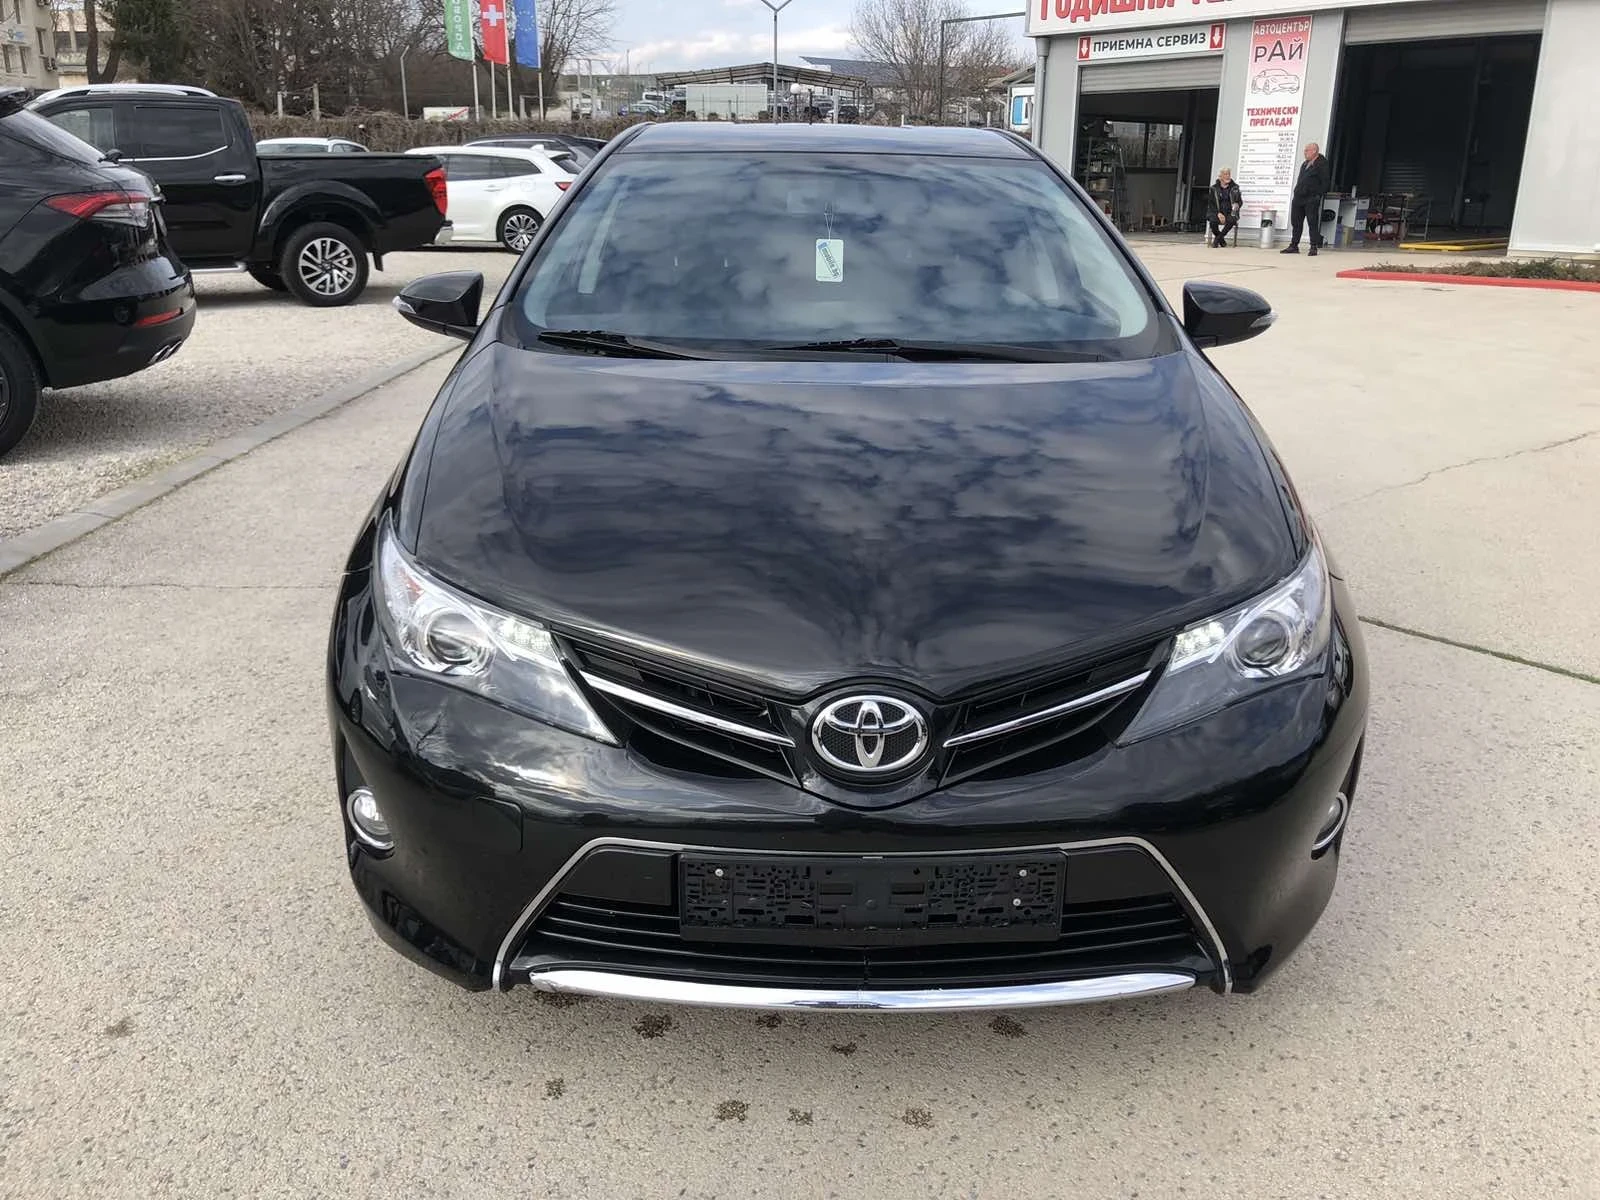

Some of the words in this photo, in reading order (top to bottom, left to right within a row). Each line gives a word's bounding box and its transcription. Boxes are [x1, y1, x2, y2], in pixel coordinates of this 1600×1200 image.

[1040, 0, 1175, 23] ГОДИ
[1253, 20, 1309, 35] АВТОЦЕНТЪР
[1093, 35, 1153, 53] ПРИЕМНА
[1157, 32, 1206, 48] СЕРВИЗ
[1254, 38, 1304, 63] РАЙ
[1246, 106, 1299, 117] ТЕХНИЧЕСКИ
[1249, 117, 1293, 128] ПРЕГЛЕДИ
